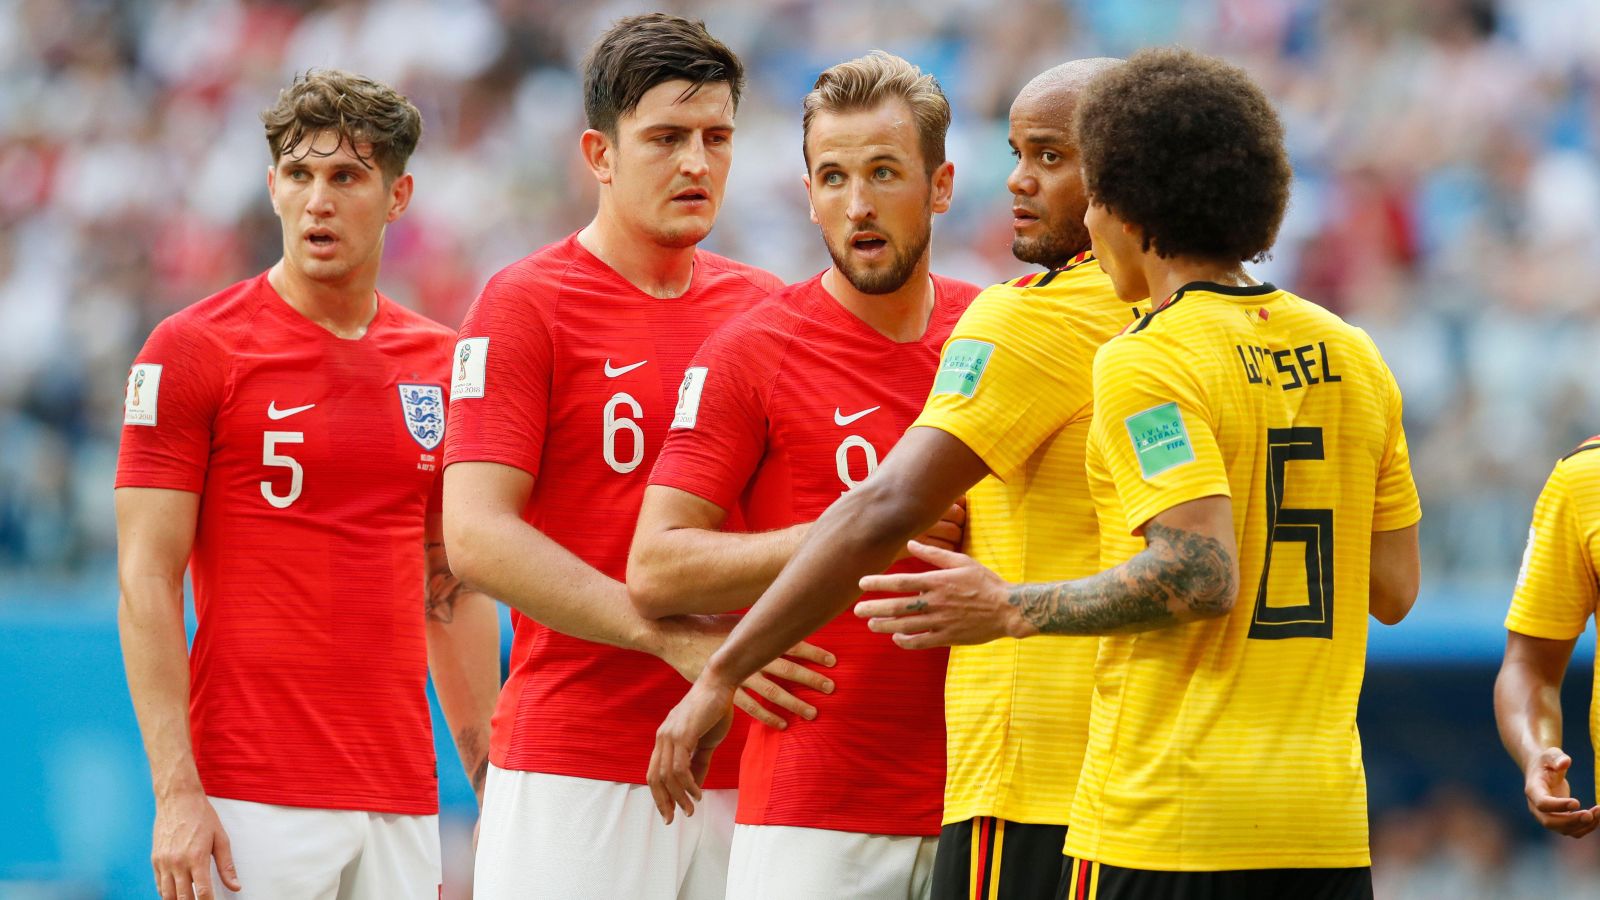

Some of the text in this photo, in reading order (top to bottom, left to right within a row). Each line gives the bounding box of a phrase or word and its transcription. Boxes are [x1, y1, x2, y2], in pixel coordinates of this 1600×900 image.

[1236, 341, 1342, 391] WSEL
[602, 392, 645, 474] 6
[1135, 420, 1179, 442] LIVING
[1166, 439, 1185, 450] FIFA
[260, 430, 304, 509] 5
[1247, 426, 1334, 640] 6
